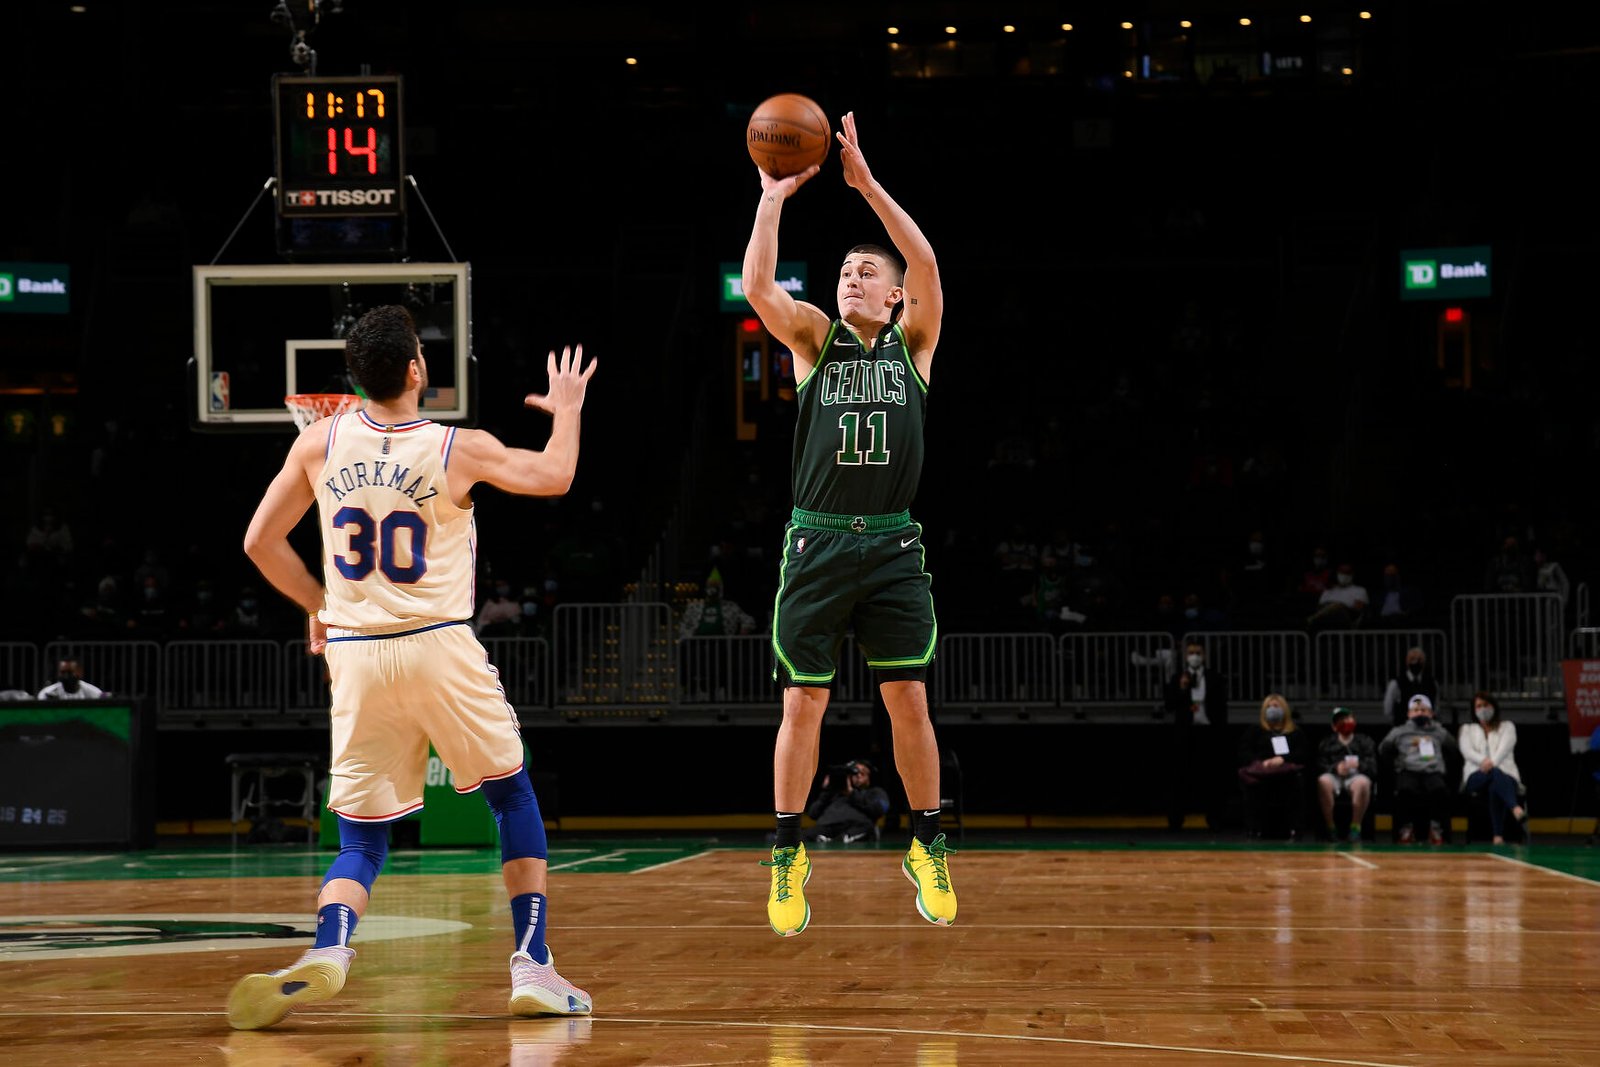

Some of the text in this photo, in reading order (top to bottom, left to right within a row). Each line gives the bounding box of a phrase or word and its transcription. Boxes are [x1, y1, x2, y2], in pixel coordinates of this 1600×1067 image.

[306, 89, 385, 119] 11:17
[327, 126, 377, 176] 14
[749, 128, 801, 149] SPALDING
[316, 189, 396, 206] TISSOT
[18, 278, 66, 294] Bank
[1407, 261, 1487, 284] TD Bank
[820, 359, 907, 406] CELTICS
[836, 410, 891, 466] 11
[325, 460, 438, 508] KORKMAZ
[332, 505, 428, 585] 30
[22, 807, 42, 825] 24
[46, 808, 67, 825] 25
